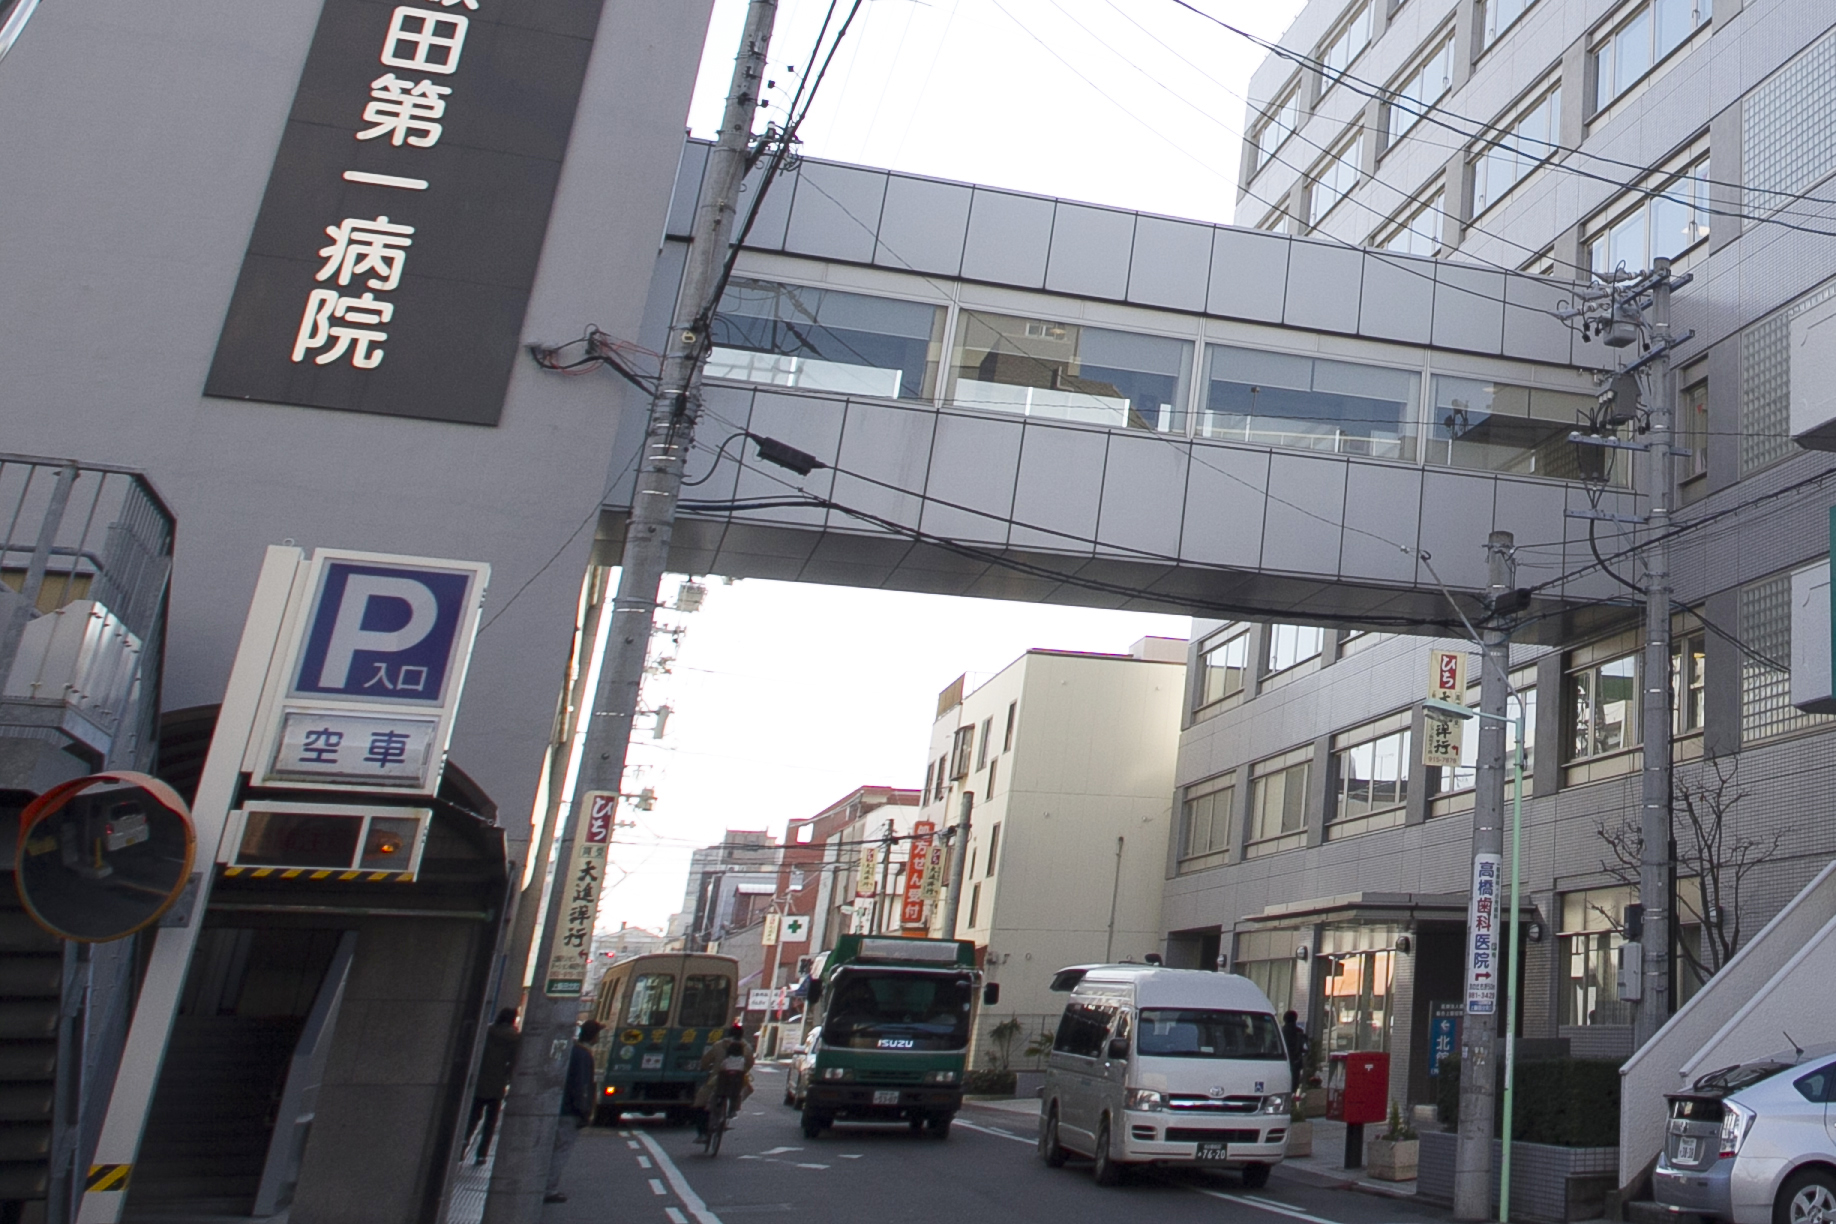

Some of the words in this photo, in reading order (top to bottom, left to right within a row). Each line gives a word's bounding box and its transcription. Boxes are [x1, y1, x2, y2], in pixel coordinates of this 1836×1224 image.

[317, 572, 439, 690] P
[363, 661, 429, 692] 入口
[1441, 655, 1457, 688] ひち
[299, 727, 412, 768] 空車
[590, 797, 612, 841] ひち
[1473, 861, 1496, 970] 高橋歯科医院
[877, 1039, 914, 1048] ISUZU
